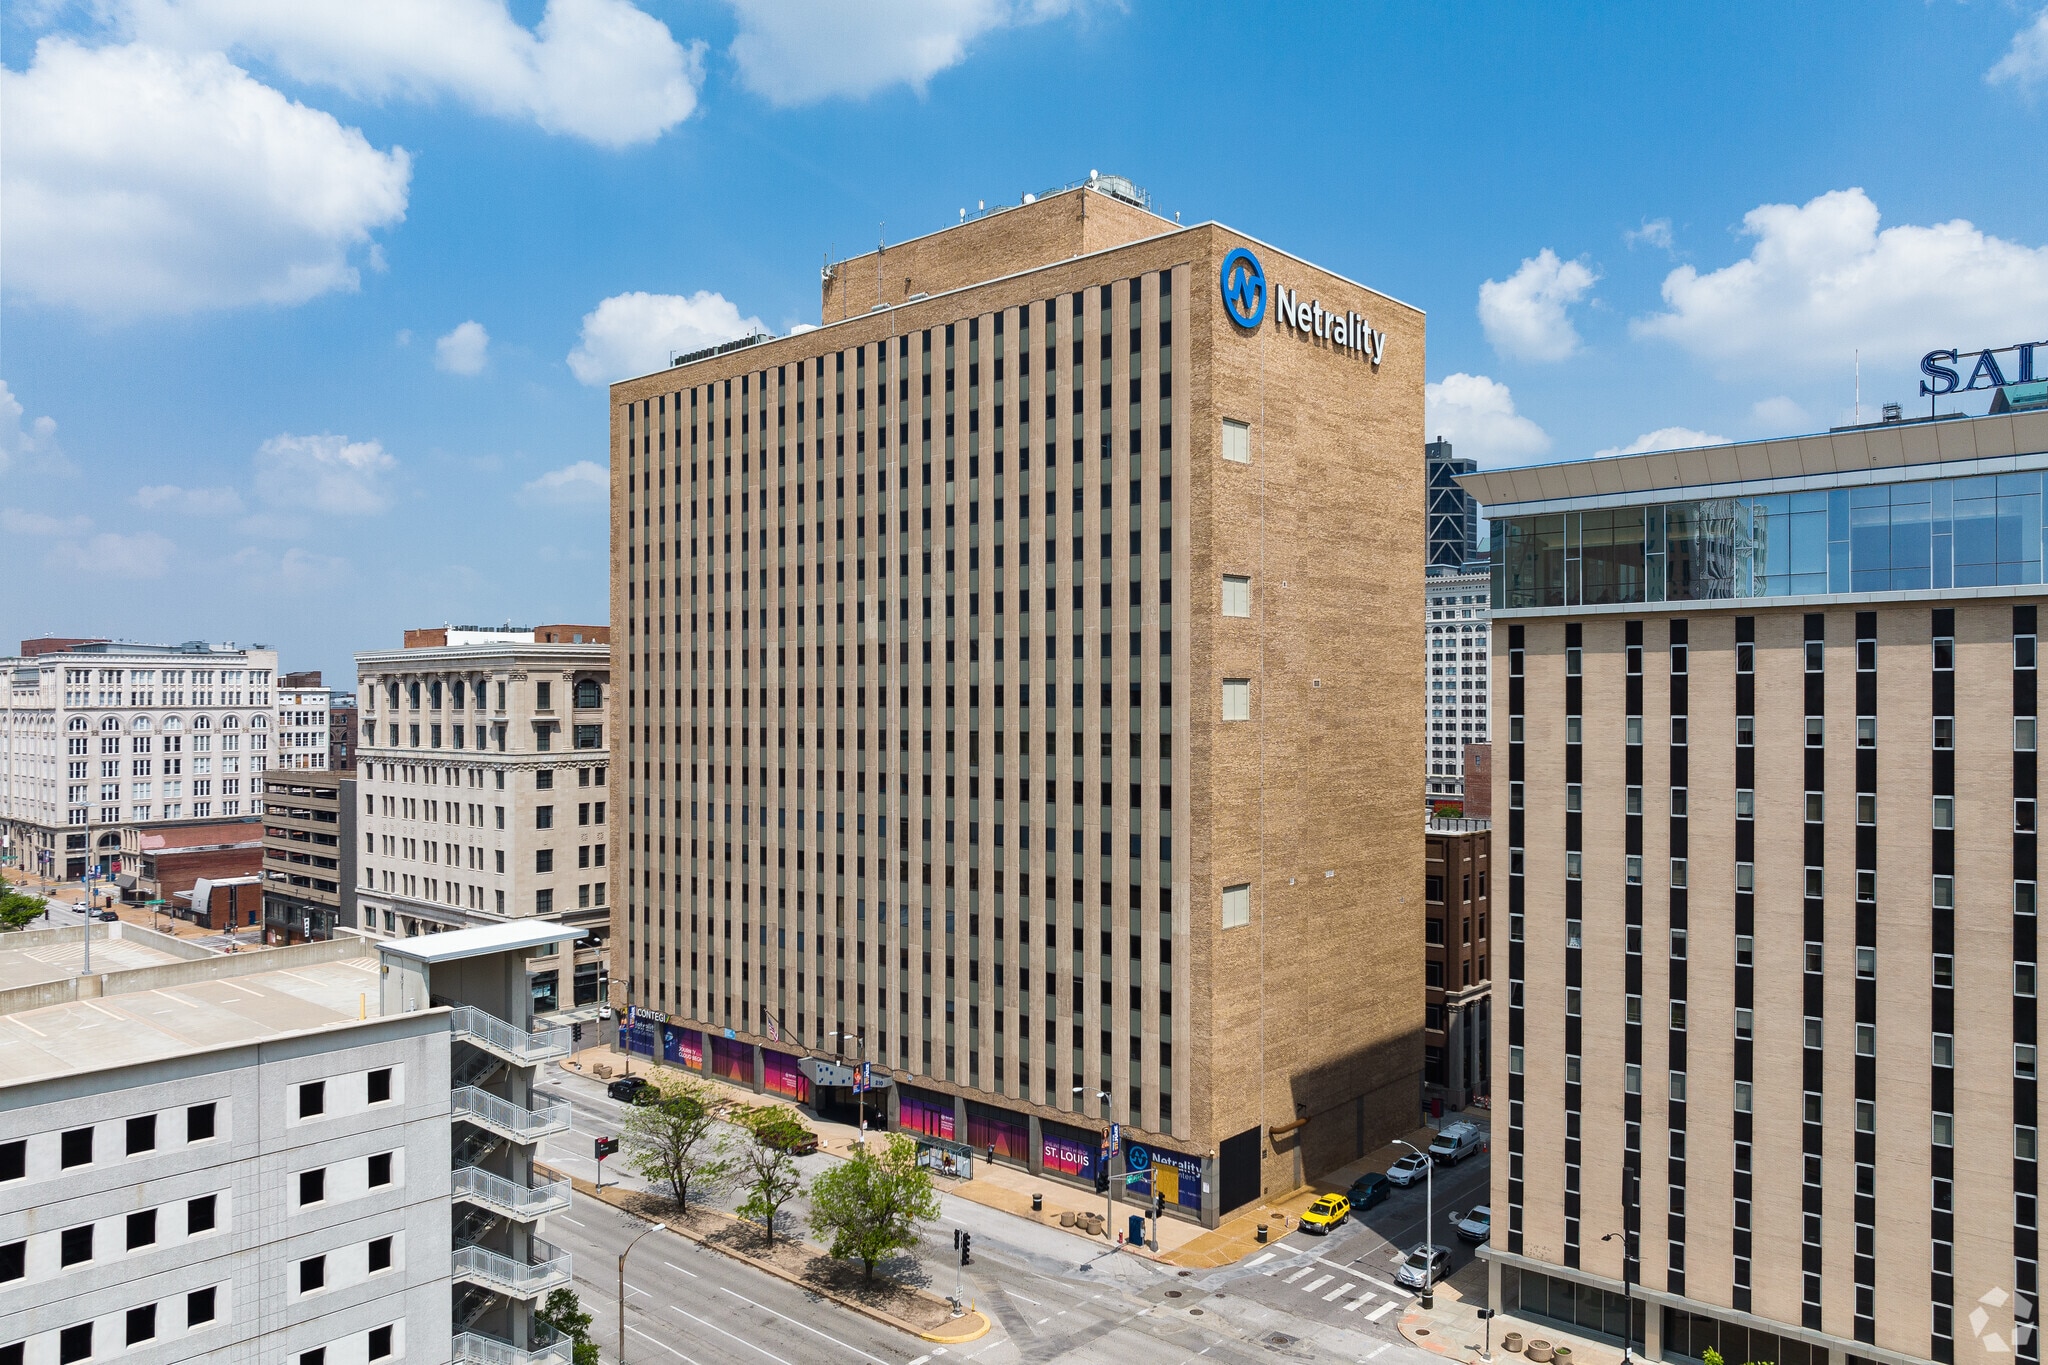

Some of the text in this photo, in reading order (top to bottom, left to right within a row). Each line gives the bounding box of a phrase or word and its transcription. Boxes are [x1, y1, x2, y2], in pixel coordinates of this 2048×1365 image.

[1275, 284, 1386, 365] Netrality
[1045, 1146, 1058, 1158] ST.
[1060, 1149, 1089, 1167] LOUIS
[1152, 1152, 1202, 1179] Netrality
